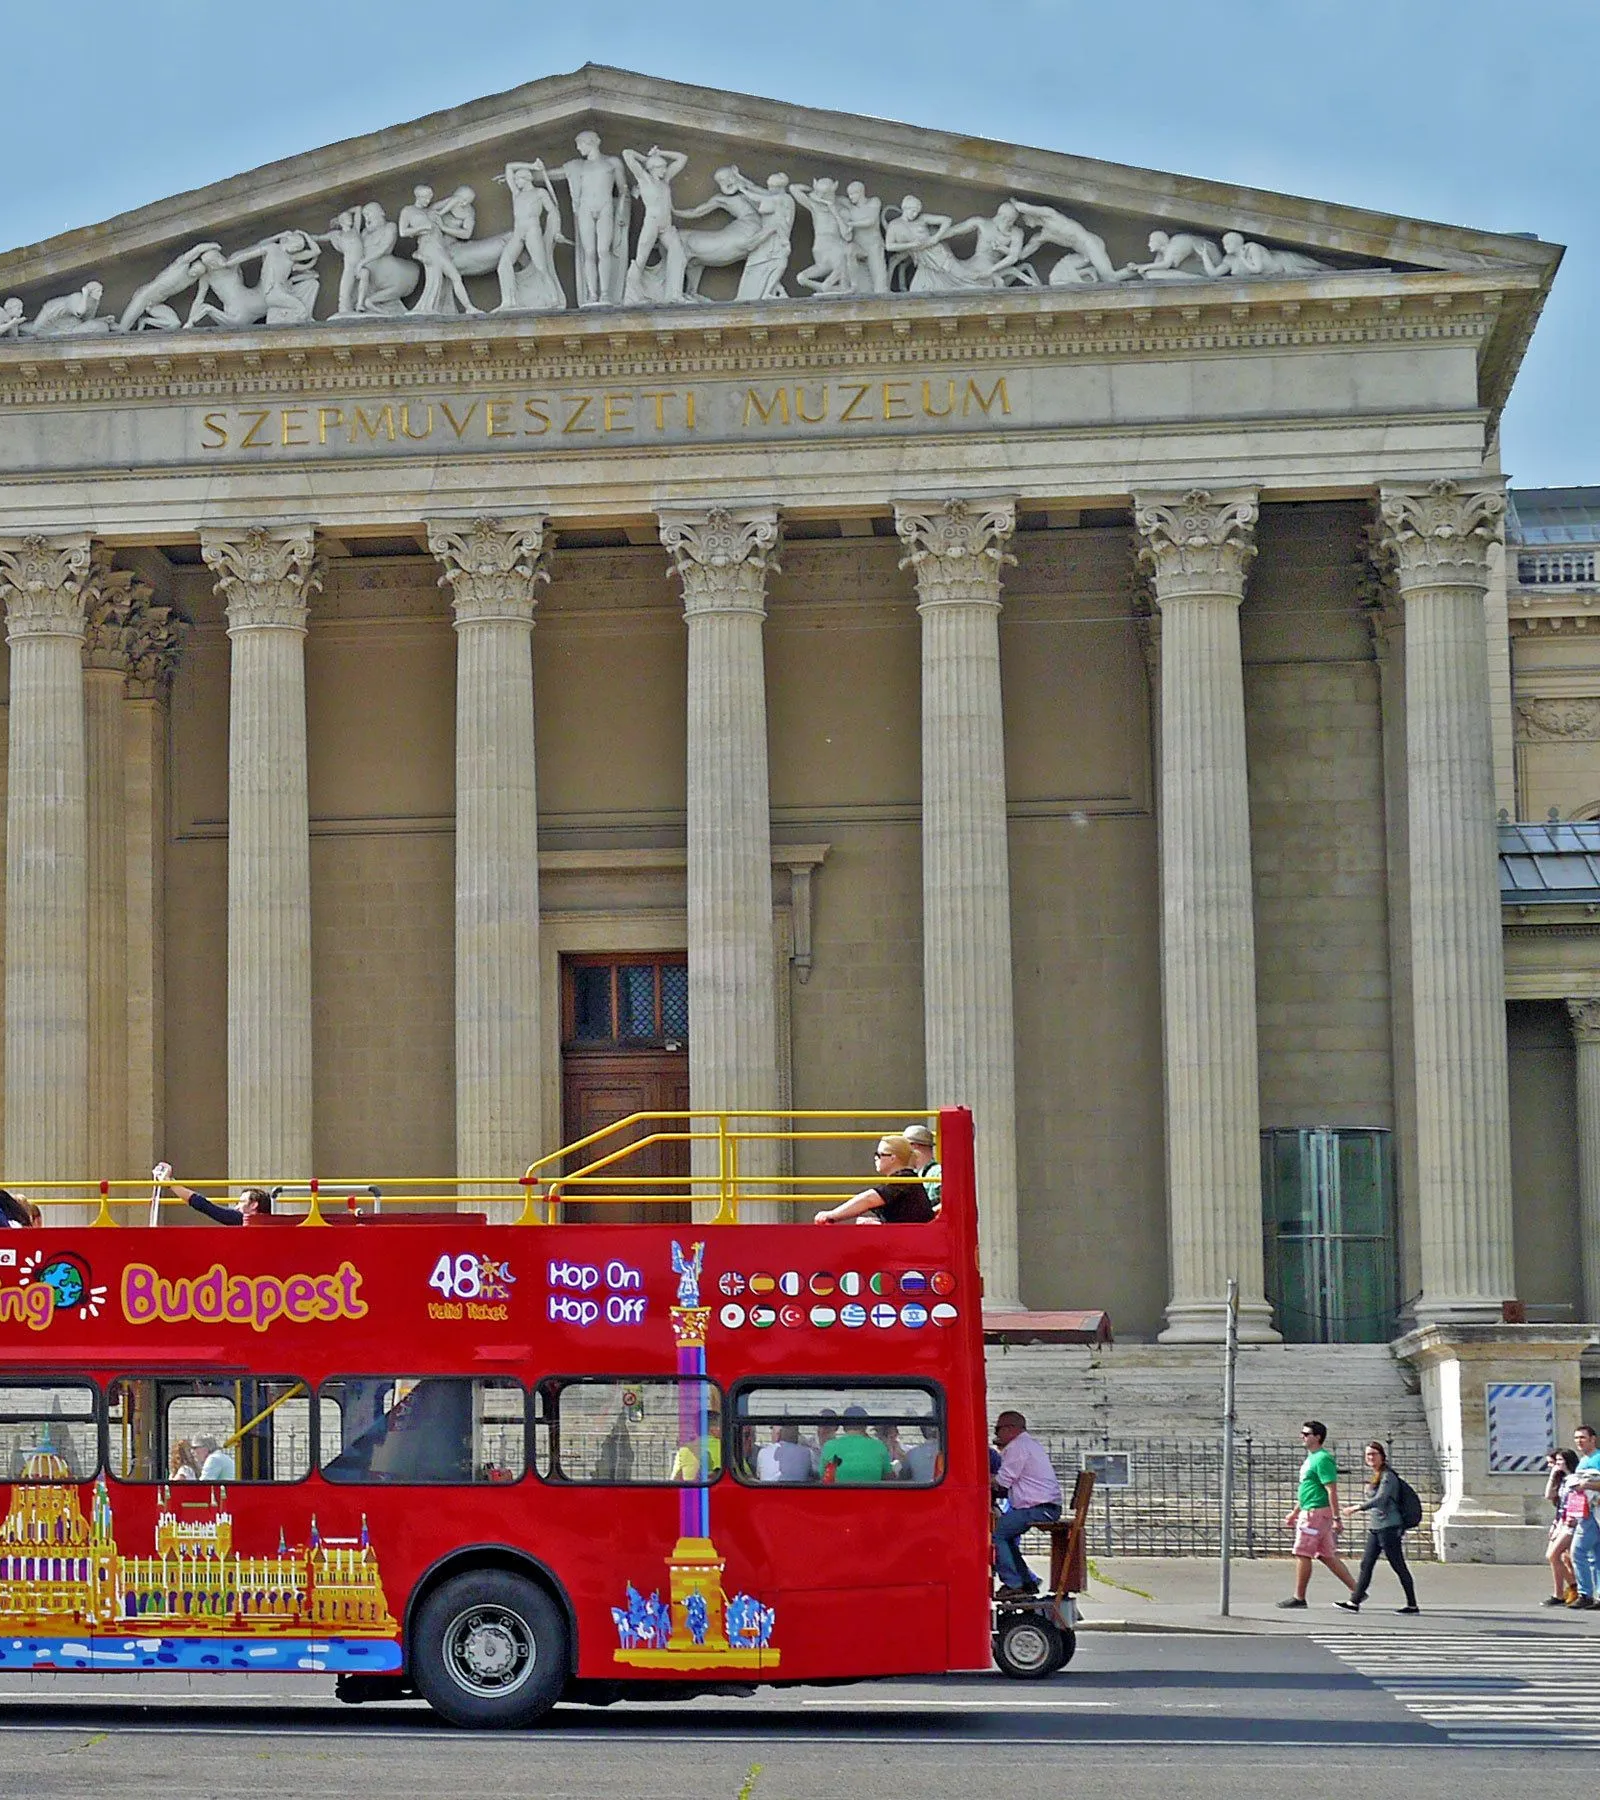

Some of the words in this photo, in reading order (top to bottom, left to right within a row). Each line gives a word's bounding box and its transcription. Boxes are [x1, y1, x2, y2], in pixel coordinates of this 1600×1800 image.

[428, 1253, 482, 1299] 48
[550, 1262, 599, 1291] Hop
[606, 1261, 640, 1289] On
[121, 1261, 369, 1332] Budapest
[428, 1302, 463, 1321] Valid
[467, 1301, 508, 1322] Ticket
[550, 1296, 599, 1326] Hop
[606, 1296, 646, 1324] Off
